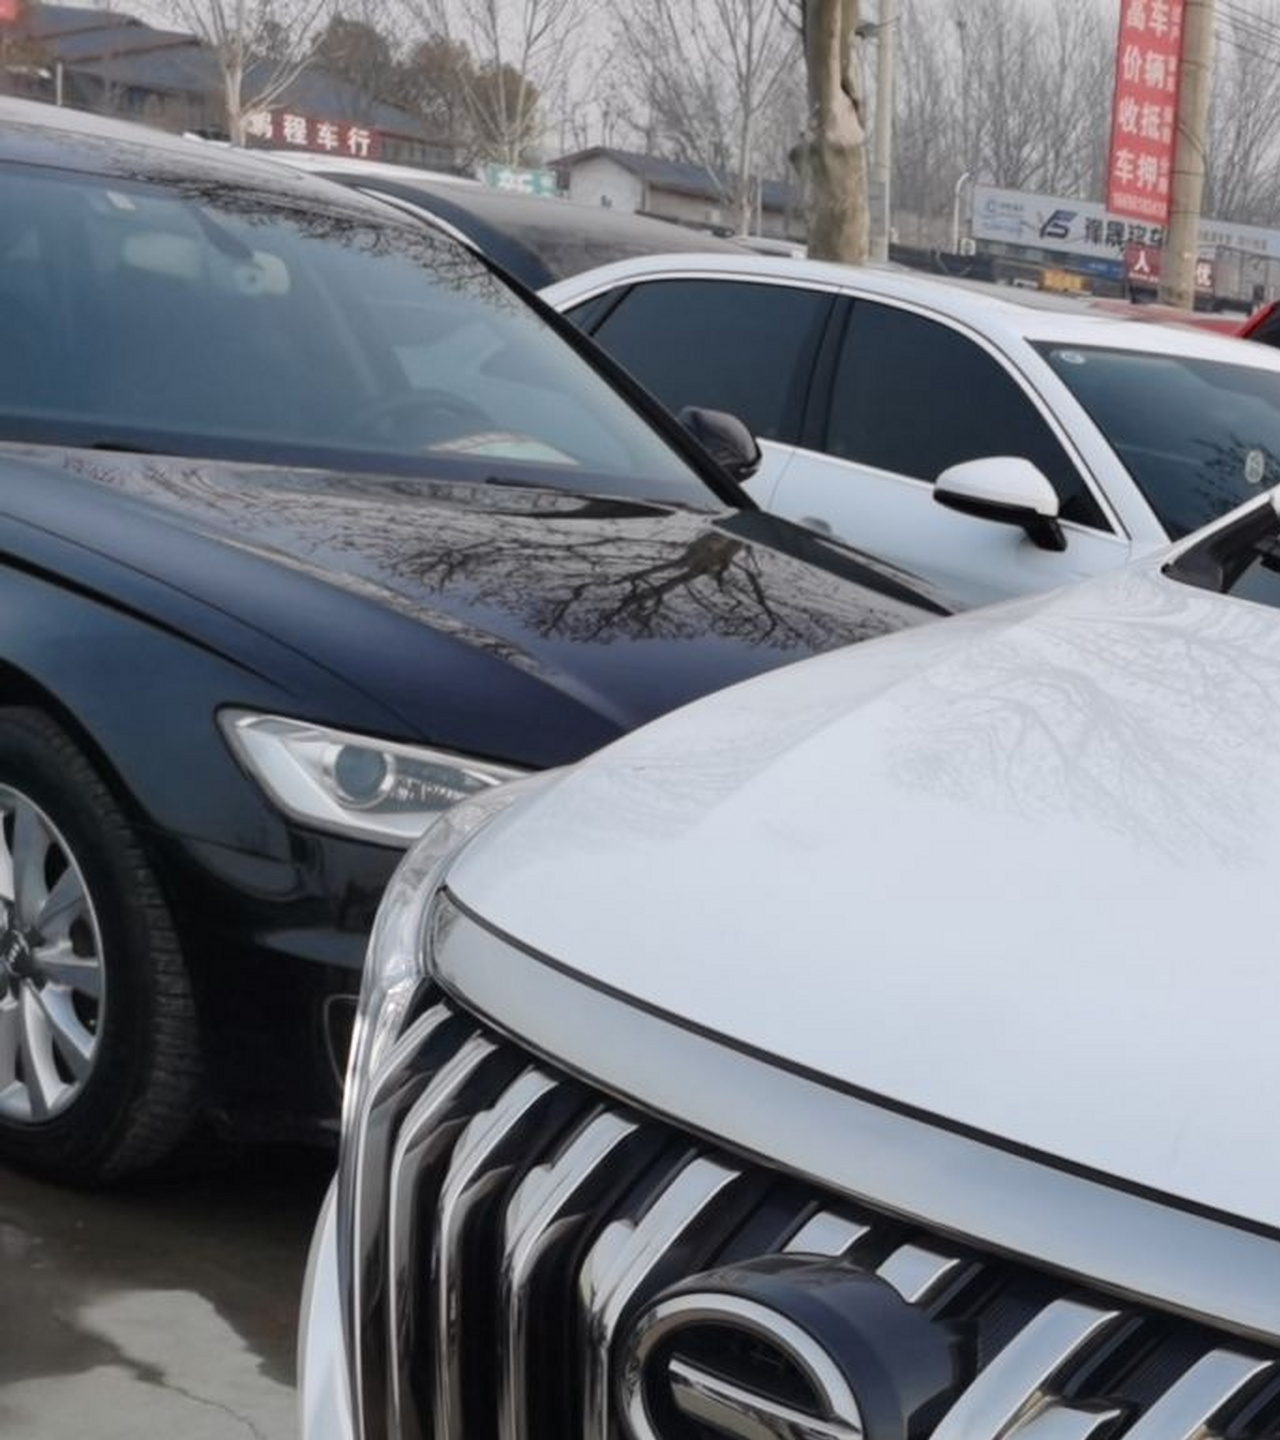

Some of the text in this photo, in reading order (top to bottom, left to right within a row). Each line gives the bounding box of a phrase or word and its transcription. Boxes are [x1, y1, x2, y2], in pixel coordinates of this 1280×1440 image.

[1113, 0, 1147, 186] 高价收车
[1137, 0, 1170, 192] 车辆抵押
